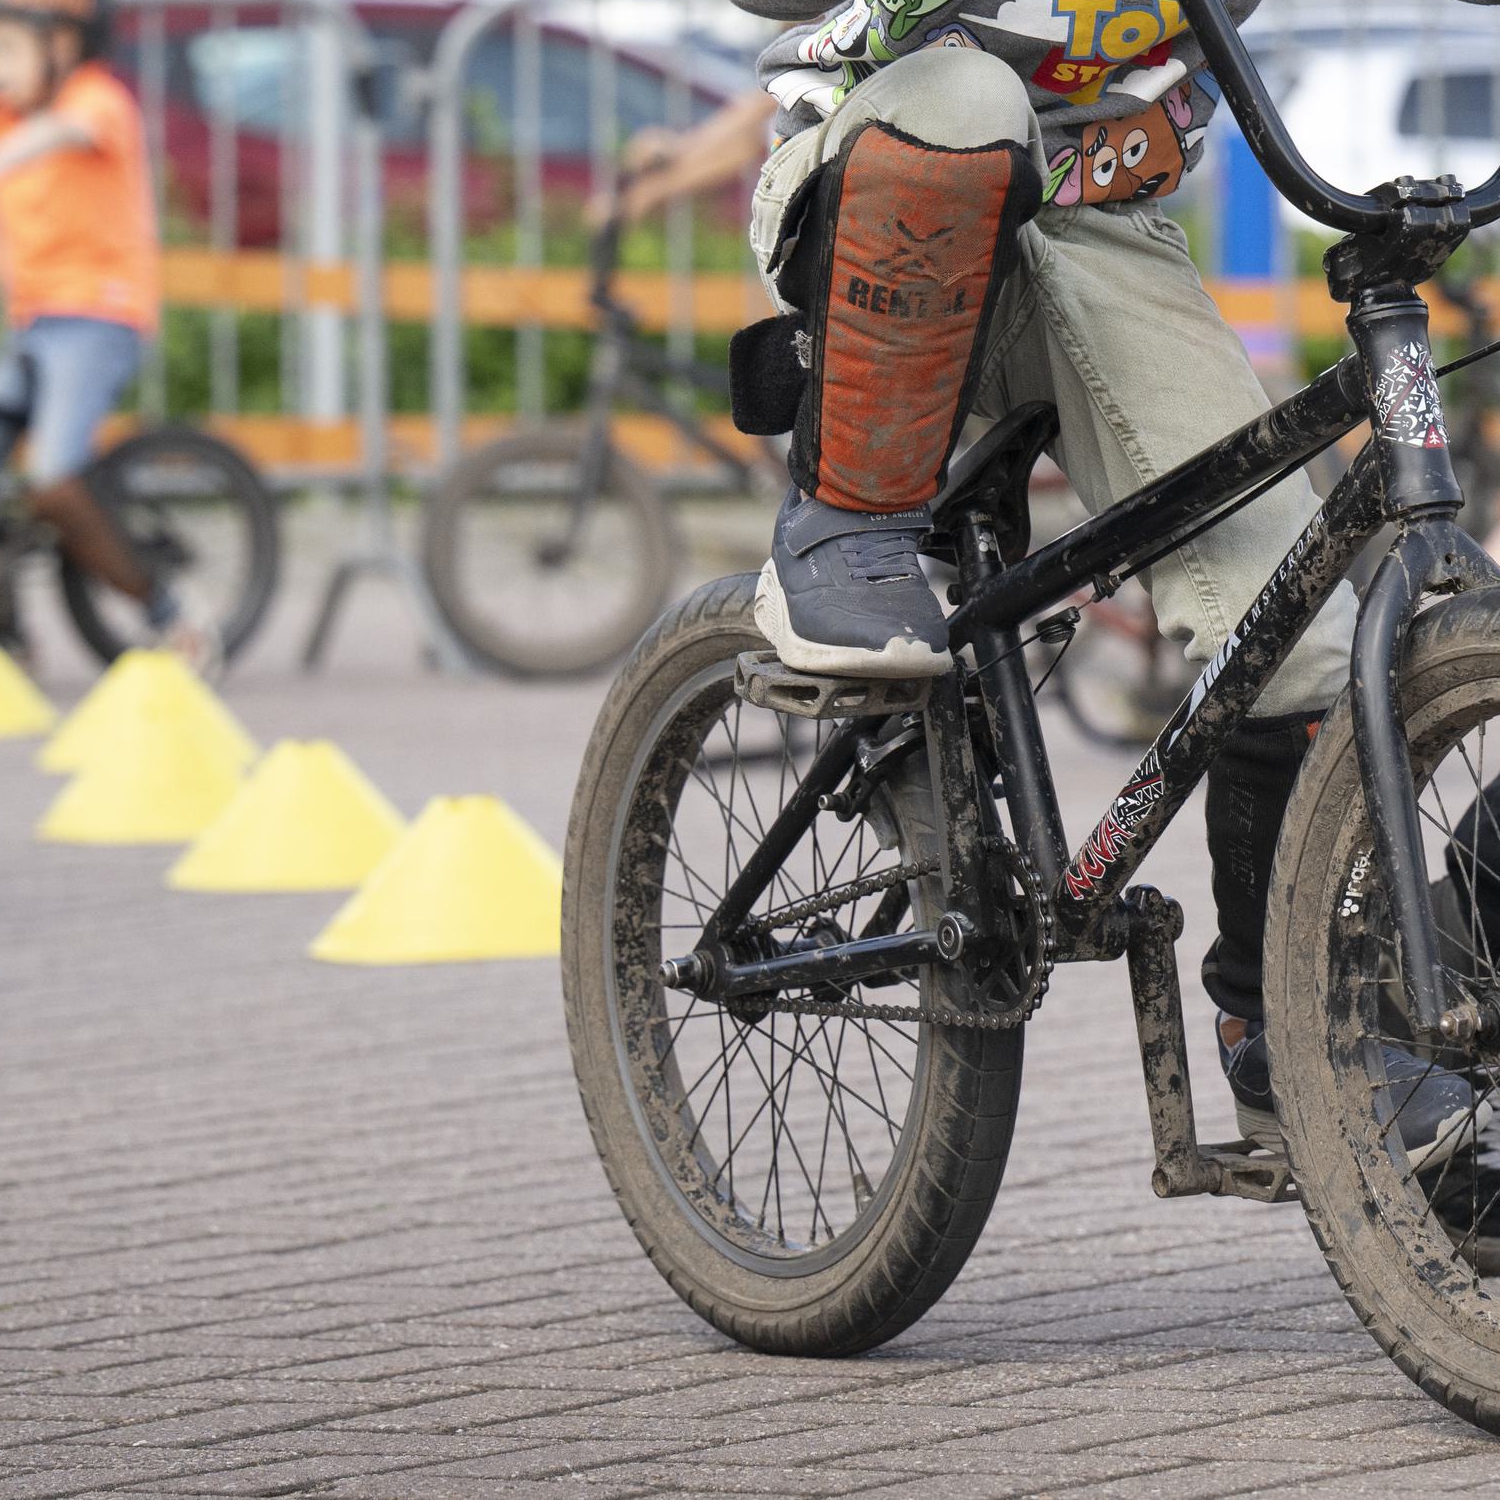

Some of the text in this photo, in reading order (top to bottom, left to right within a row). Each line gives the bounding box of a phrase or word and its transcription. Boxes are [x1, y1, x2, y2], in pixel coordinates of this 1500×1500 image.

[848, 276, 966, 318] RENTL
[1242, 508, 1327, 636] AMSTERDAM
[1065, 806, 1137, 900] NOVA
